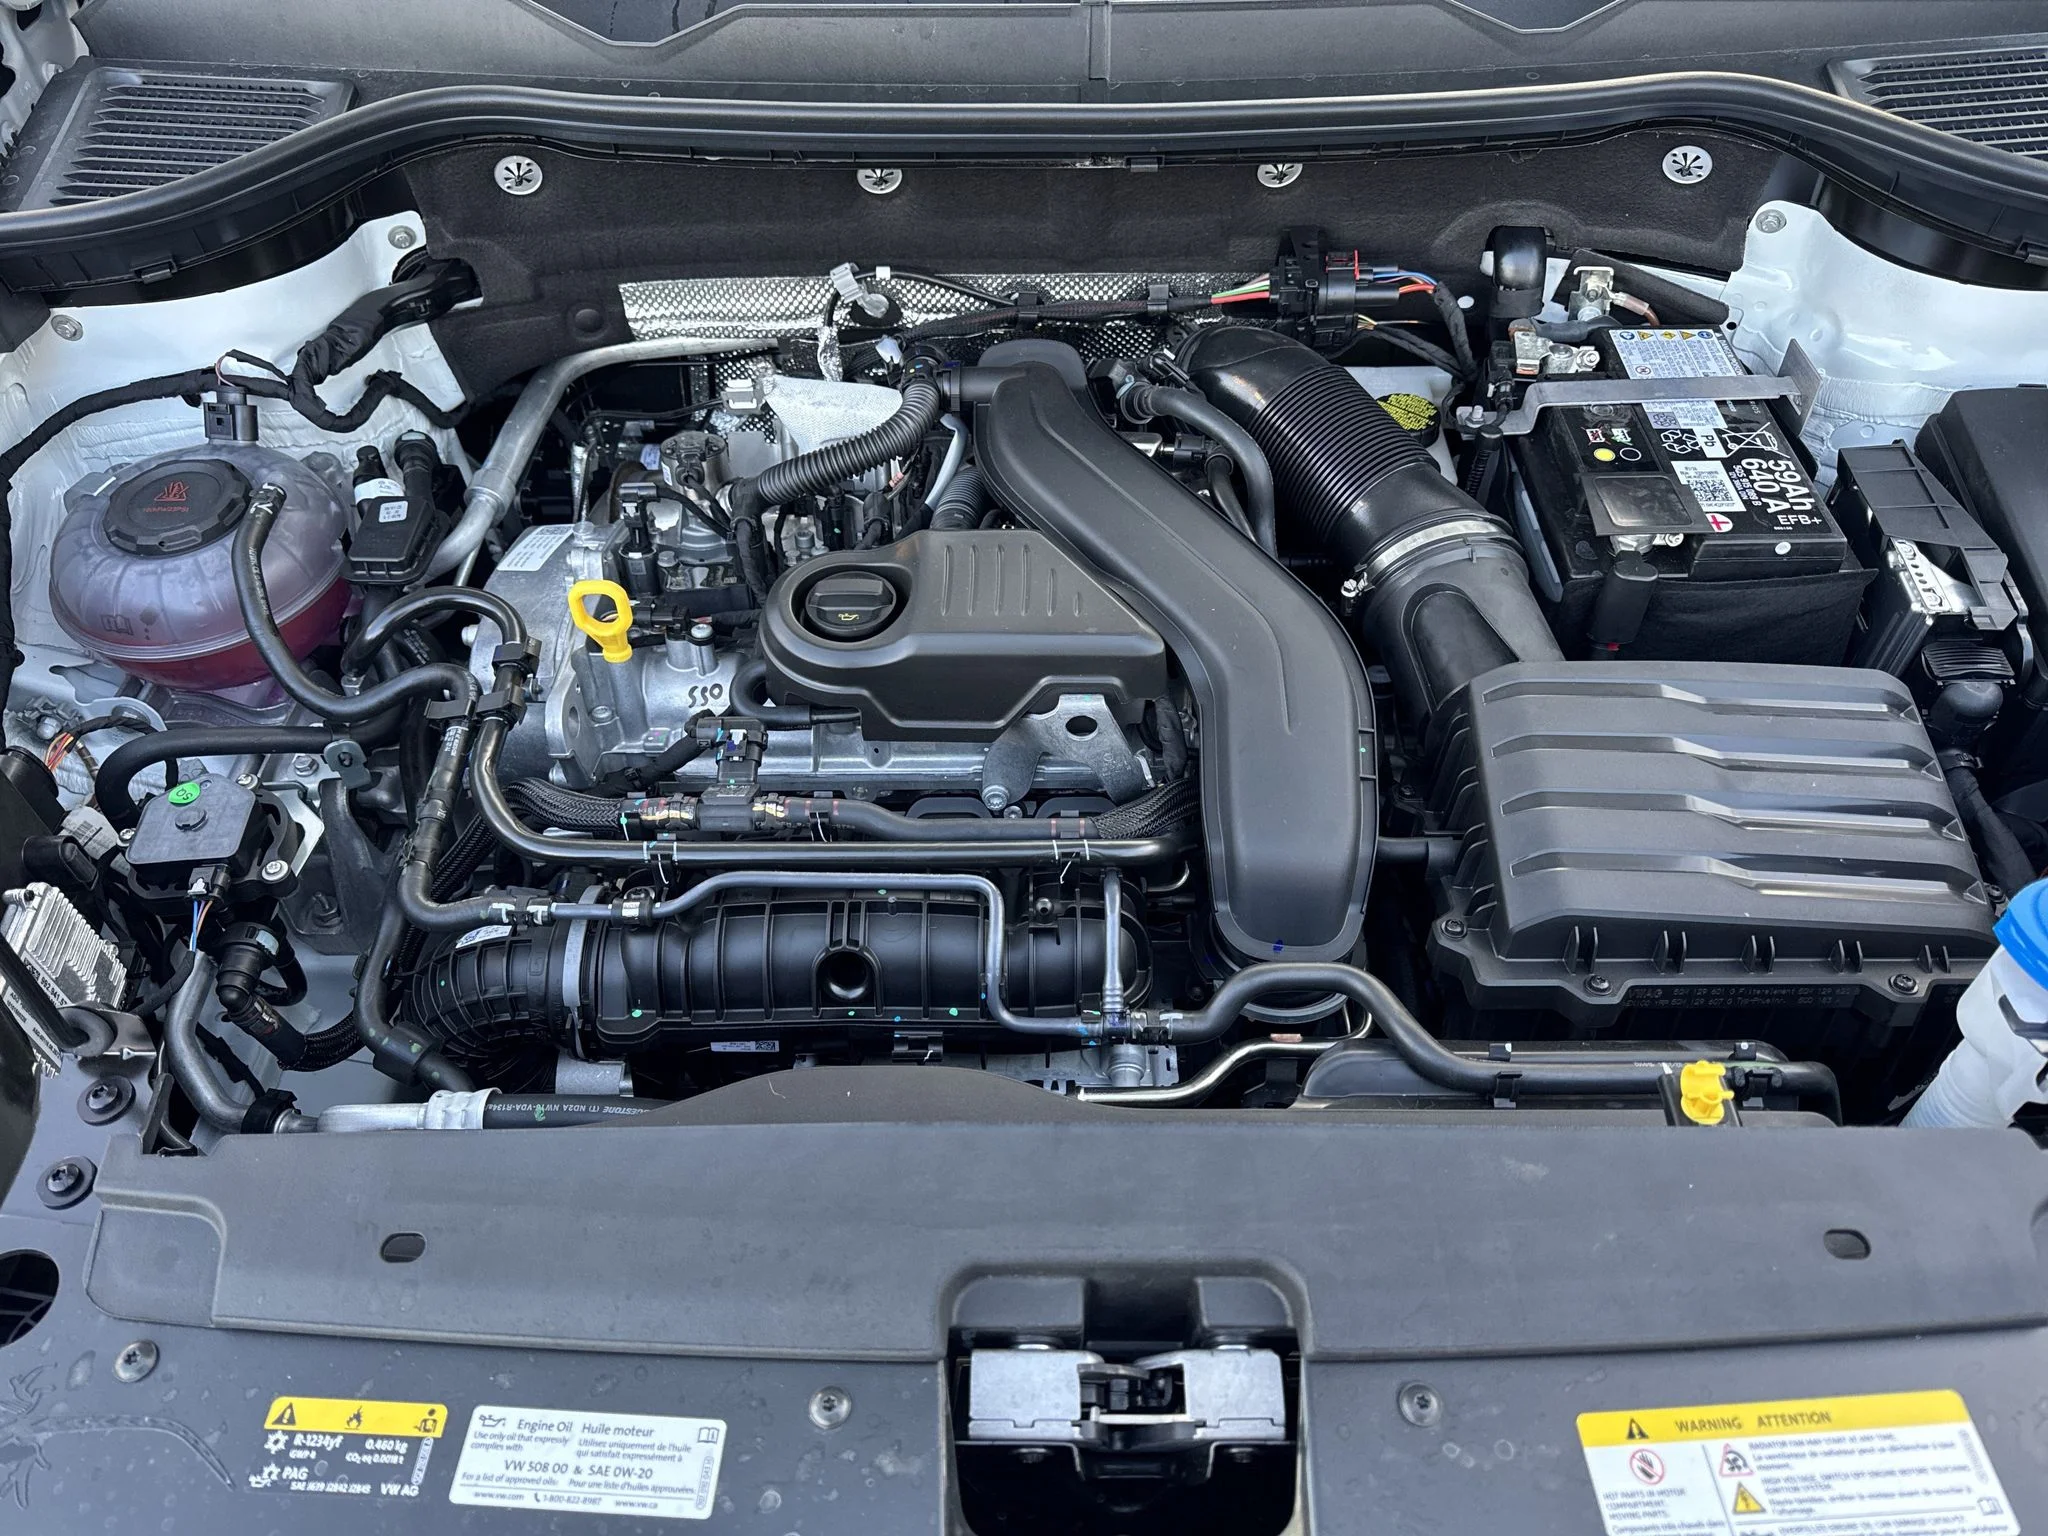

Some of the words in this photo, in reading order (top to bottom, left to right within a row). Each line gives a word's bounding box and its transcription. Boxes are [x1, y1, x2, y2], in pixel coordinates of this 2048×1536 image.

[1749, 400, 1761, 414] RIOS
[1700, 434, 1717, 447] Pb
[1740, 458, 1781, 493] 640
[1768, 460, 1816, 511] 59Ah
[1760, 498, 1791, 514] A
[1777, 514, 1822, 525] EFB+
[517, 1418, 555, 1433] Engine
[556, 1421, 573, 1432] Oil
[1675, 1416, 1742, 1433] WARNING
[1757, 1411, 1832, 1430] ATTENTION
[581, 1423, 611, 1435] Huile
[613, 1425, 655, 1437] moteur
[293, 1433, 344, 1451] R-1234yf
[394, 1440, 408, 1454] kg
[473, 1431, 489, 1439] Use
[489, 1432, 506, 1441] only
[507, 1433, 517, 1441] oil
[518, 1433, 533, 1441] that
[534, 1435, 569, 1446] expressly
[578, 1438, 607, 1448] Utilisez
[608, 1441, 655, 1451] uniquement
[657, 1443, 667, 1452] de
[668, 1443, 692, 1453] l'huile
[470, 1442, 504, 1452] complies
[505, 1444, 524, 1452] with
[576, 1449, 588, 1458] qui
[590, 1449, 621, 1459] satisfait
[282, 1466, 309, 1480] PAG
[504, 1459, 526, 1472] VW
[527, 1461, 550, 1473] 508
[552, 1462, 569, 1474] 00
[573, 1465, 583, 1475] &
[588, 1464, 611, 1477] SAE
[613, 1466, 653, 1480] 0W-20
[462, 1471, 475, 1479] For
[475, 1473, 481, 1481] a
[482, 1472, 494, 1480] list
[495, 1474, 505, 1483] of
[505, 1475, 542, 1485] approved
[568, 1478, 586, 1488] Pour
[587, 1480, 603, 1489] une
[603, 1480, 620, 1489] liste
[620, 1481, 649, 1491] d'huiles
[381, 1483, 401, 1495] VW
[400, 1484, 419, 1497] AG
